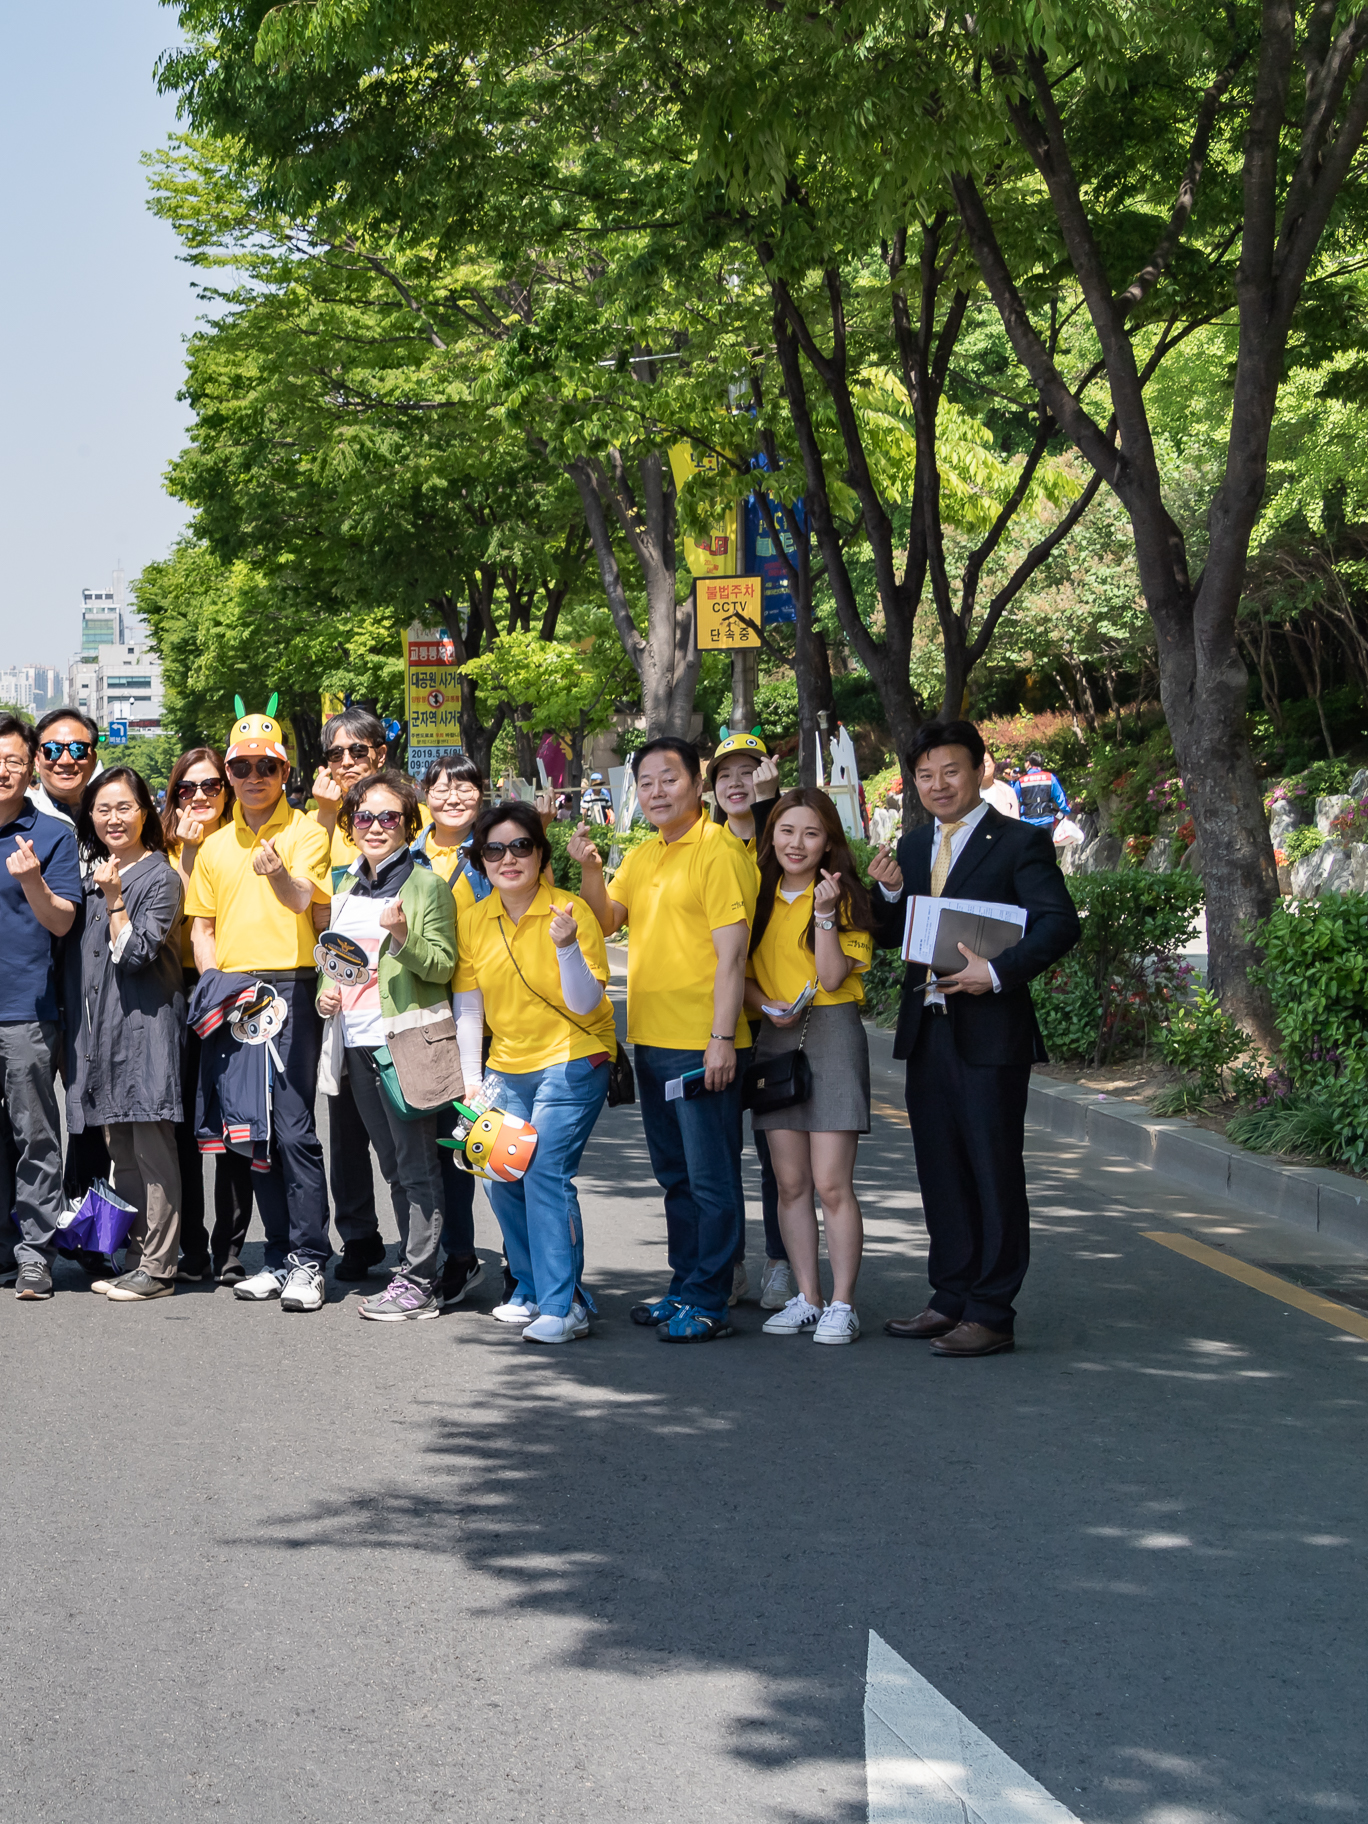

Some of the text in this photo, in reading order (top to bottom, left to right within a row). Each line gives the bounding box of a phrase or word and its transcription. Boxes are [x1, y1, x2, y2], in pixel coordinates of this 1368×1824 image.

[706, 583, 755, 600] 불법주차
[712, 601, 747, 613] CCTV
[411, 671, 437, 689] 대공원
[411, 710, 437, 727] 군자역
